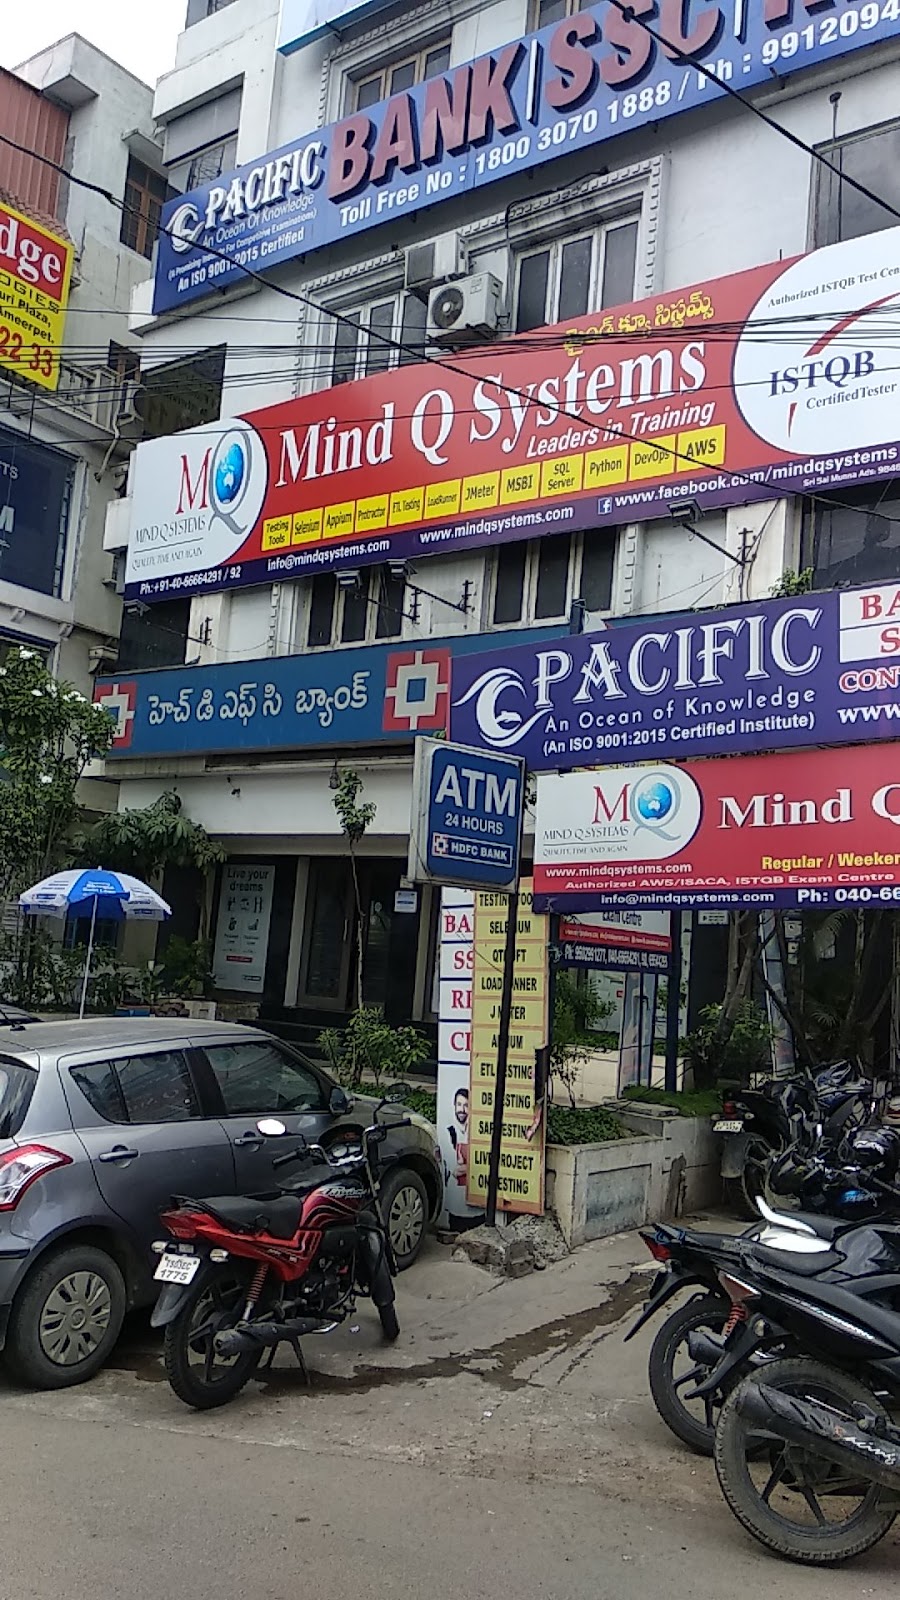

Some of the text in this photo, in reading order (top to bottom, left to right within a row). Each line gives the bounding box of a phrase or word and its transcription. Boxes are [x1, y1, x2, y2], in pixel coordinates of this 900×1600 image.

[329, 0, 721, 202] BANK SSC
[340, 204, 371, 227] Toll
[377, 184, 420, 217] Free
[426, 172, 453, 195] No
[475, 137, 531, 174] 1800
[537, 109, 598, 151] 3070
[607, 81, 672, 124] 1888
[761, 0, 900, 65] 9912094
[205, 141, 323, 230] PACIFIC
[216, 222, 246, 244] Ocean
[262, 193, 315, 223] Knowledge
[0, 216, 62, 284] dge
[177, 277, 190, 293] An
[191, 267, 206, 287] ISO
[260, 226, 305, 257] Certified
[767, 286, 819, 308] Authorized
[821, 276, 856, 294] ISTQB
[857, 271, 878, 284] Test
[18, 299, 52, 328] Plaza,
[767, 350, 875, 398] ISTQB
[274, 340, 708, 488] Mind Q Systems
[526, 401, 716, 459] Leaders in Training
[634, 448, 670, 465] DevOps
[685, 437, 717, 459] AWS
[553, 462, 570, 475] SQL
[589, 458, 622, 476] Python
[464, 484, 495, 501] JMeter
[506, 473, 533, 494] MSBI
[547, 476, 575, 491] Server
[266, 520, 289, 533] Testing
[294, 519, 320, 535] Selenium
[326, 513, 352, 530] Appium
[420, 505, 574, 544] www.mindqsystems.com
[268, 534, 286, 545] Tools
[267, 538, 390, 572] info@mindqsystems.com
[531, 607, 823, 710] PACIFIC
[839, 666, 900, 693] CON
[544, 688, 816, 734] An Ocean of Knowledge
[542, 711, 816, 757] (An ISO 9001:2015 Certified Institute)
[434, 764, 518, 818] ATM
[717, 788, 853, 829] Mind
[444, 812, 504, 836] 24 HOURS
[543, 828, 572, 840] MIND
[584, 825, 629, 838] SYSTEMS
[451, 841, 508, 861] HDFC BANK
[227, 867, 269, 881] Live your
[545, 861, 692, 878] www.mindqsystems.com
[761, 856, 824, 872] Regular
[229, 881, 264, 892] dreams
[565, 880, 636, 889] Authorized
[735, 875, 784, 886] ISTQB
[788, 874, 833, 884] Exam
[837, 872, 895, 882] Centre
[479, 893, 511, 907] TESTIN
[601, 891, 774, 905] info@mindqsystems.com
[797, 889, 828, 902] Ph:
[481, 976, 537, 991] LOADNNER
[480, 1062, 496, 1077] ETL
[499, 1153, 534, 1171] ROJECT
[496, 1176, 529, 1195] ESTING
[160, 1268, 189, 1281] 1775
